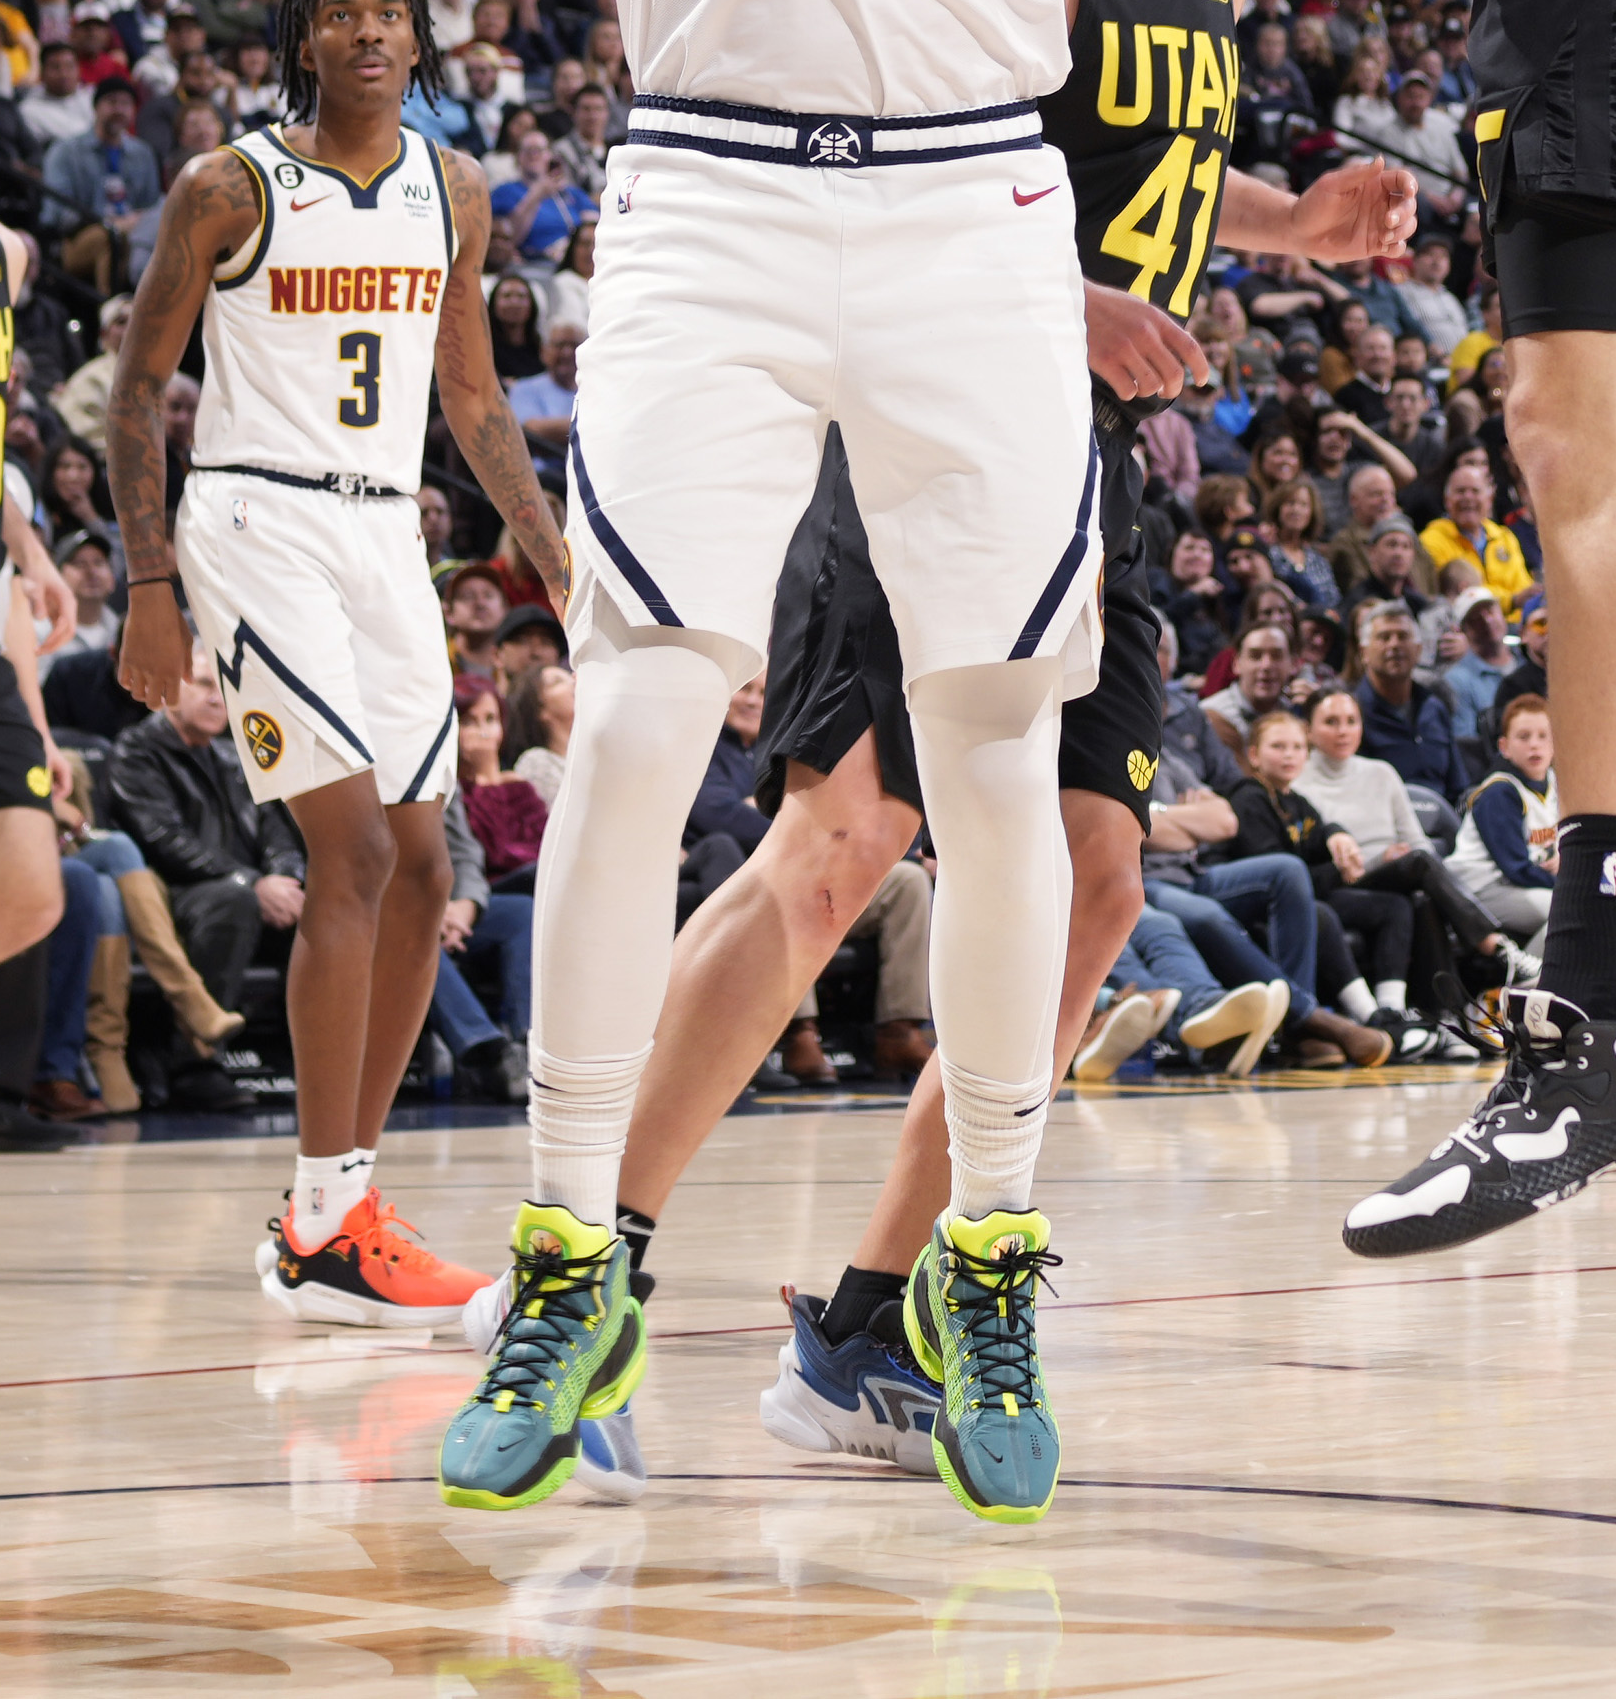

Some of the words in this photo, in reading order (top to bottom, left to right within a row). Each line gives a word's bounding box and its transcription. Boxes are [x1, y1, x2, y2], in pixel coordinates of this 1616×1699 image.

[1097, 21, 1240, 143] UTAH
[400, 182, 431, 201] WU
[1099, 133, 1222, 318] 41
[268, 267, 442, 315] NUGGETS
[337, 330, 383, 429] 3
